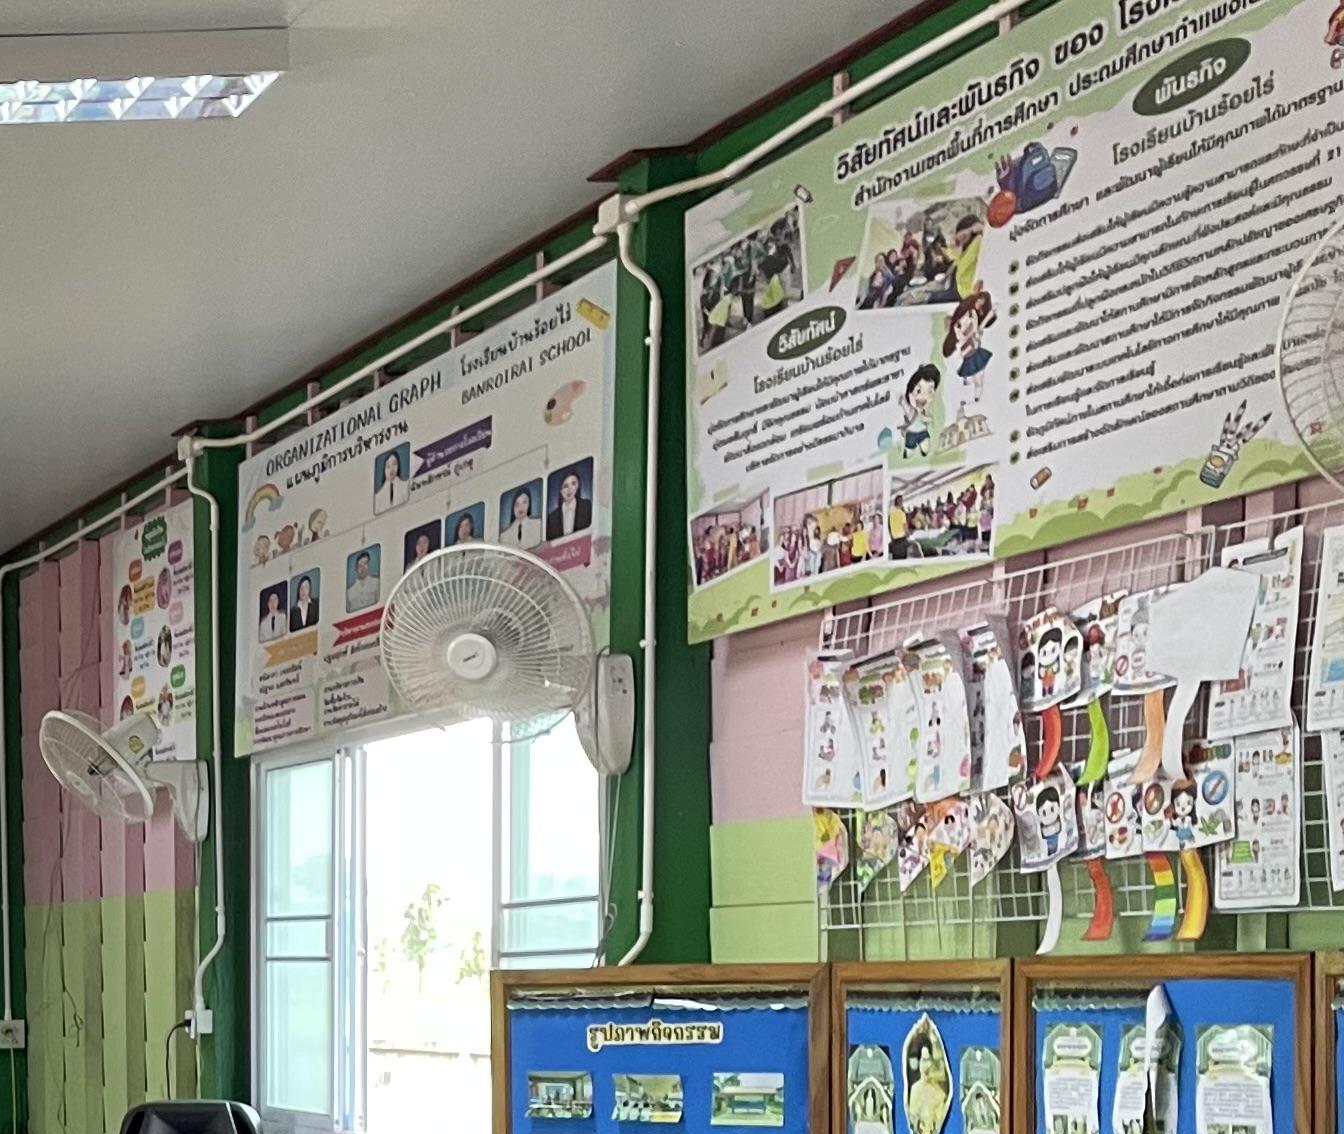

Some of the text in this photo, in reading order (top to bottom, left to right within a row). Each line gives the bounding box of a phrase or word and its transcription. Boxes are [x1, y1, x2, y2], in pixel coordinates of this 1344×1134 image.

[1055, 23, 1103, 65] ของ
[1155, 57, 1226, 105] พันธกิจ
[1112, 70, 1275, 166] โรงเรียนบ้านร้อยไร่
[461, 357, 533, 405] BANROIRAI
[266, 409, 382, 477] ORGANIZATIONAL
[389, 371, 442, 413] GRAPH
[589, 1020, 721, 1050] รูปภาพกิจกรรม
